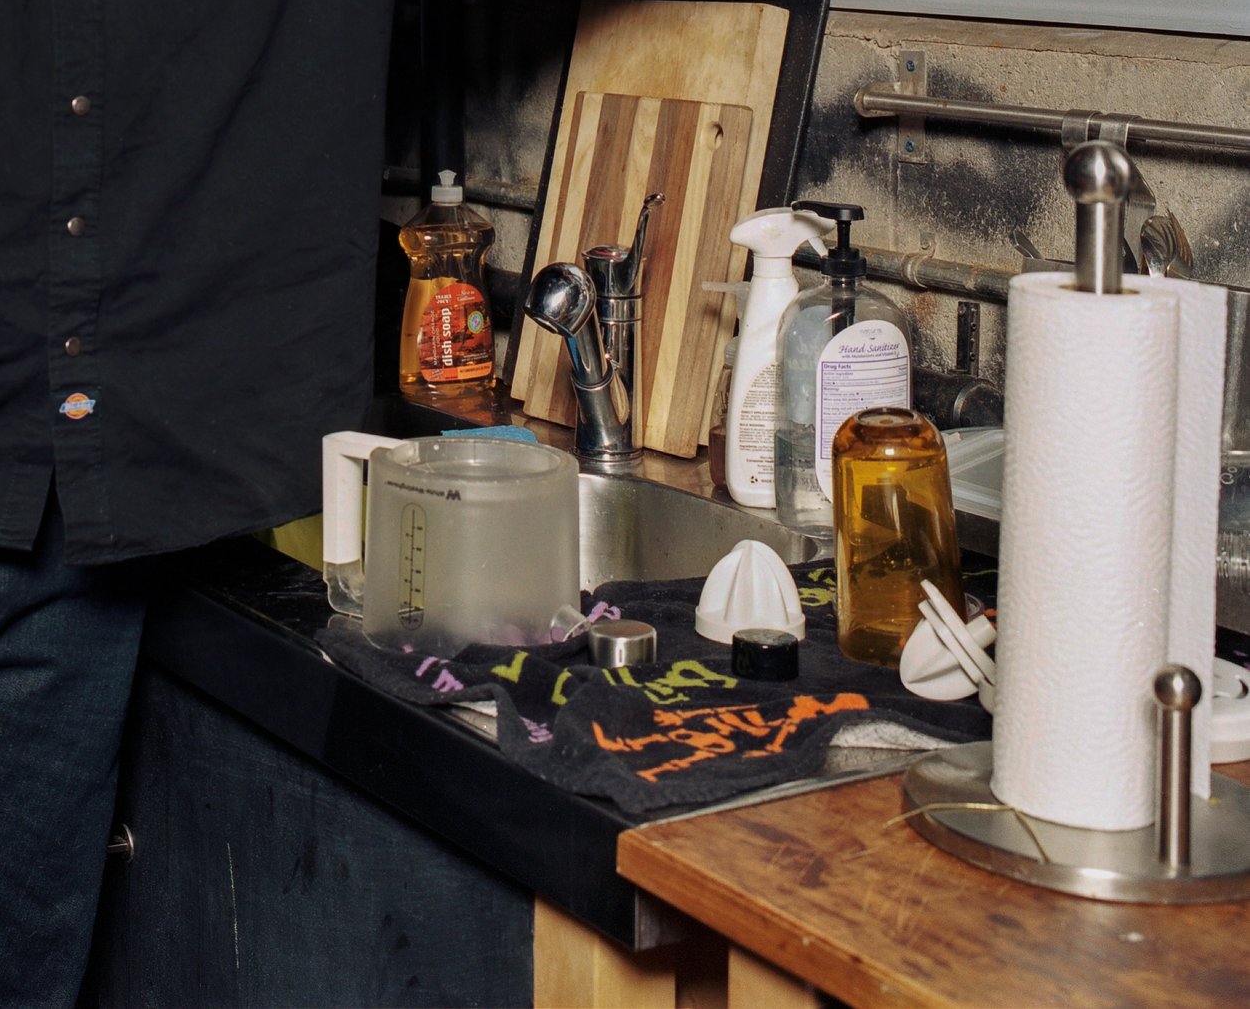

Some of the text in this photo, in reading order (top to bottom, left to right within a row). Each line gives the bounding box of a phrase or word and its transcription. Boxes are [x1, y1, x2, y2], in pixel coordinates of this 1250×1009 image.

[442, 307, 453, 366] dish soap
[838, 342, 900, 354] Hand Sanitizer
